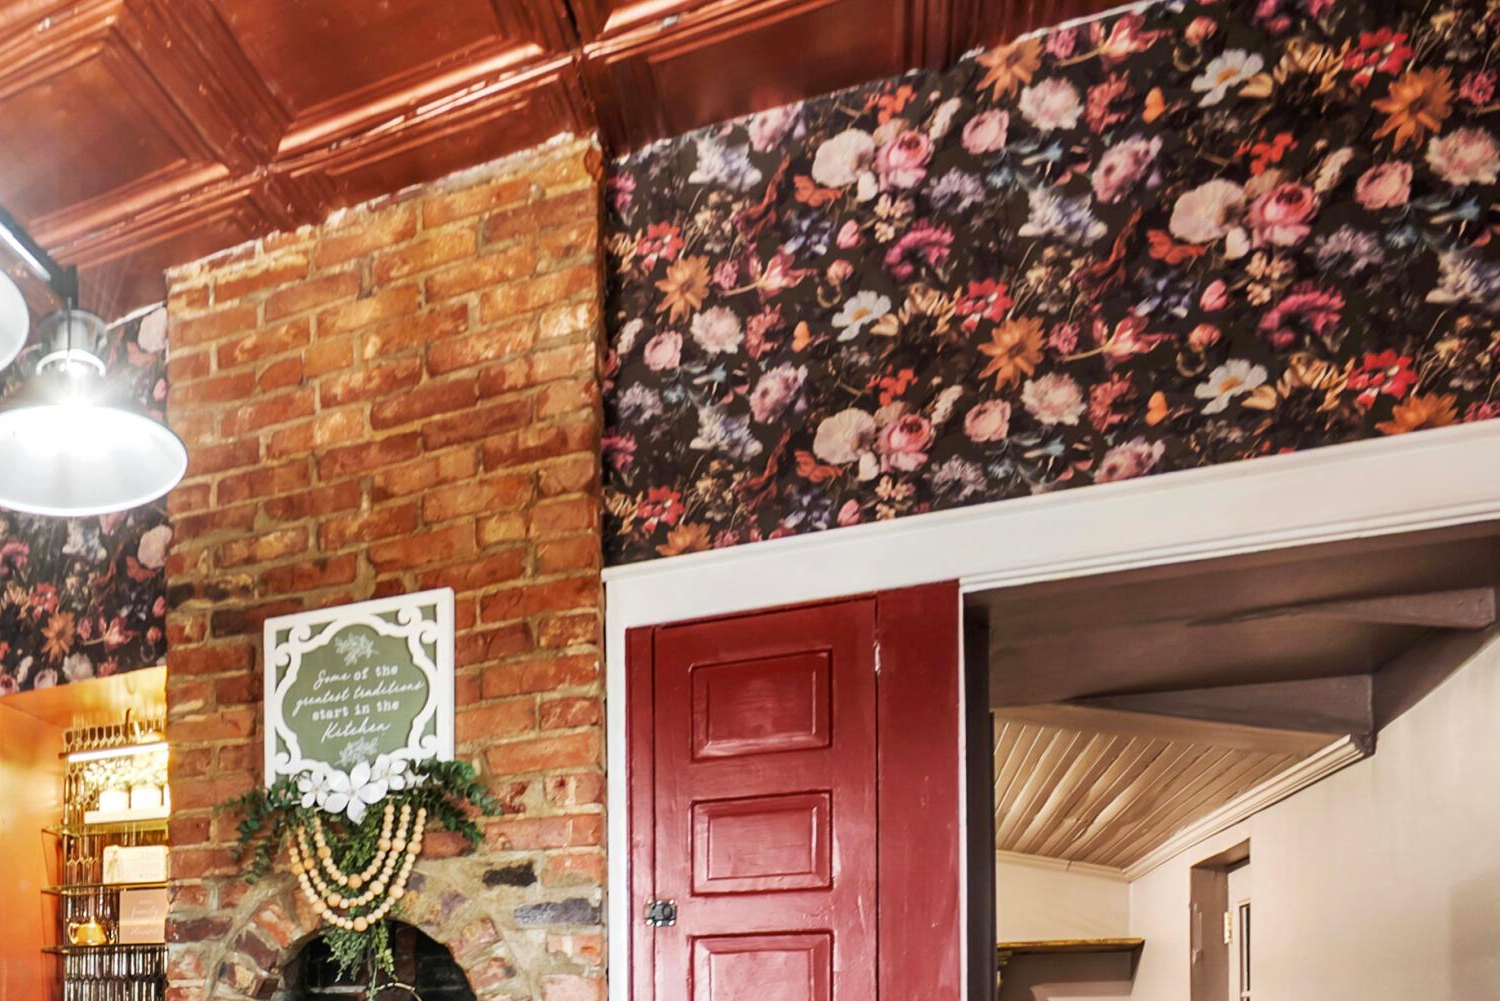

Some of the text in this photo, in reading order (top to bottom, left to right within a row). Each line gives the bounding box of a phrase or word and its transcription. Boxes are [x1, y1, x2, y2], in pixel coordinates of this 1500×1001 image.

[313, 665, 399, 691] Some of the
[292, 680, 425, 717] greatest traditions
[312, 699, 400, 721] start in the
[320, 716, 391, 744] Kitchen
